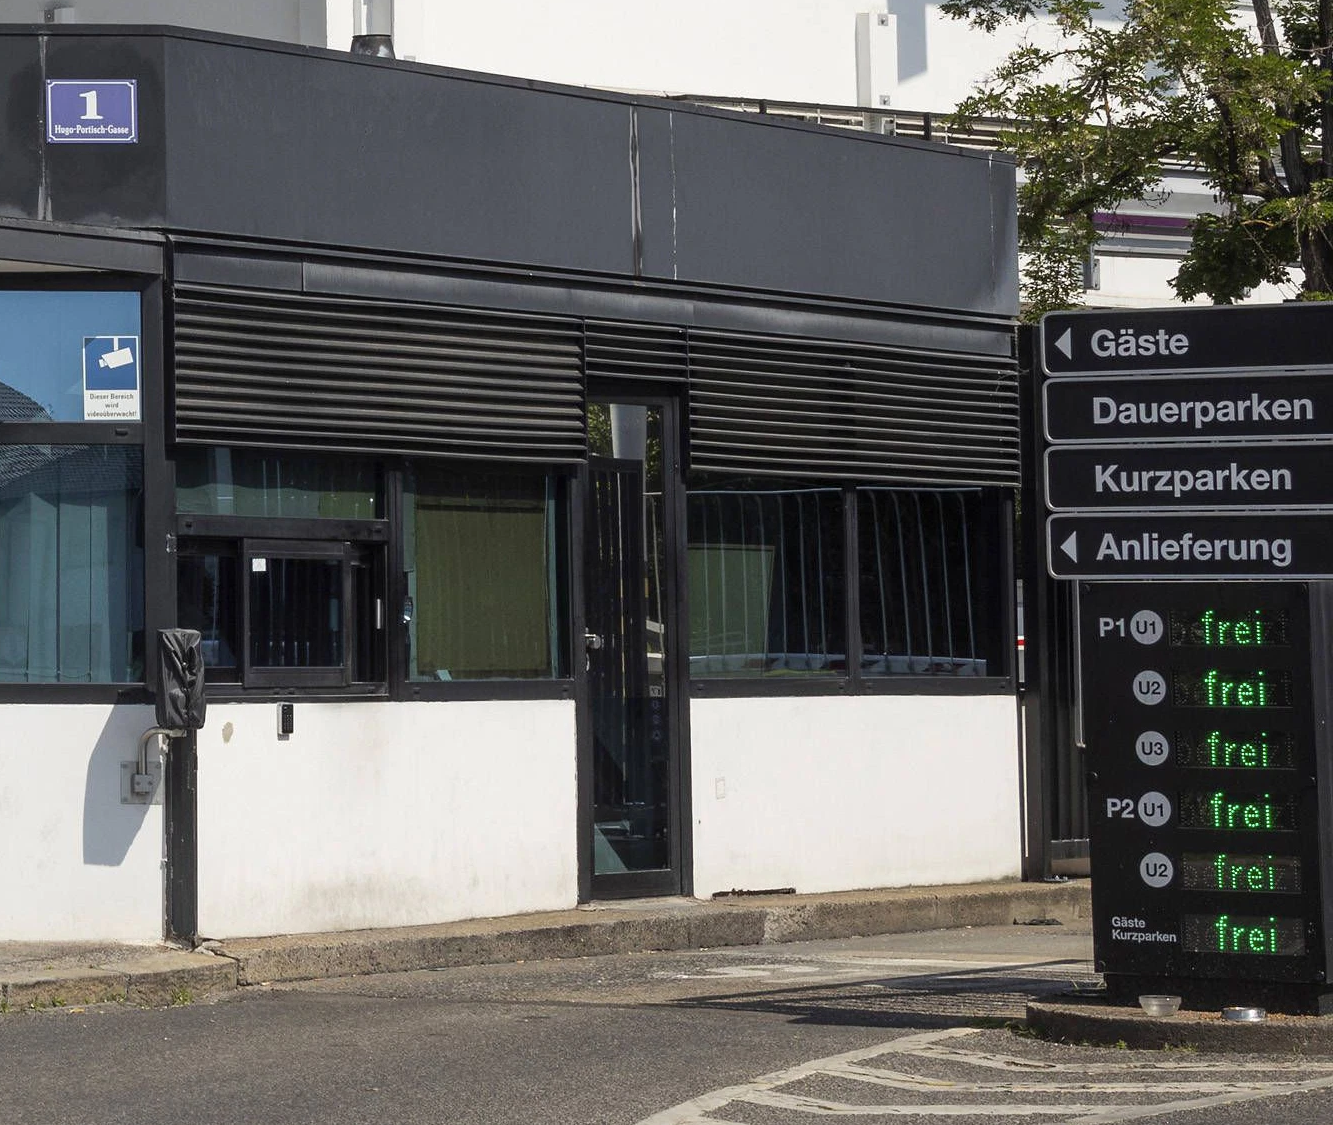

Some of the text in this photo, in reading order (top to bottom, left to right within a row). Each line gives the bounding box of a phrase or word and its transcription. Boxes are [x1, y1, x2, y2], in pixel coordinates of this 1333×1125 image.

[79, 90, 104, 120] 1
[54, 124, 129, 135] Hugo-Portisch-Gasse
[1090, 328, 1189, 358] Gäste
[1092, 393, 1313, 429] Dauerparken
[1094, 463, 1292, 497] Kurzparken
[1096, 533, 1292, 567] Anlieferung
[1099, 618, 1158, 638] P1 U1
[1201, 610, 1263, 645] frei
[1138, 680, 1161, 696] U2
[1204, 670, 1266, 706] frei
[1141, 741, 1164, 756] U3
[1207, 731, 1268, 767] frei
[1106, 798, 1165, 819] P2 U1
[1210, 792, 1272, 828] frei
[1145, 863, 1169, 878] U2
[1214, 854, 1276, 890] frei
[1111, 916, 1146, 929] Gäste
[1111, 929, 1177, 944] Kurzparken
[1215, 915, 1277, 952] frei
